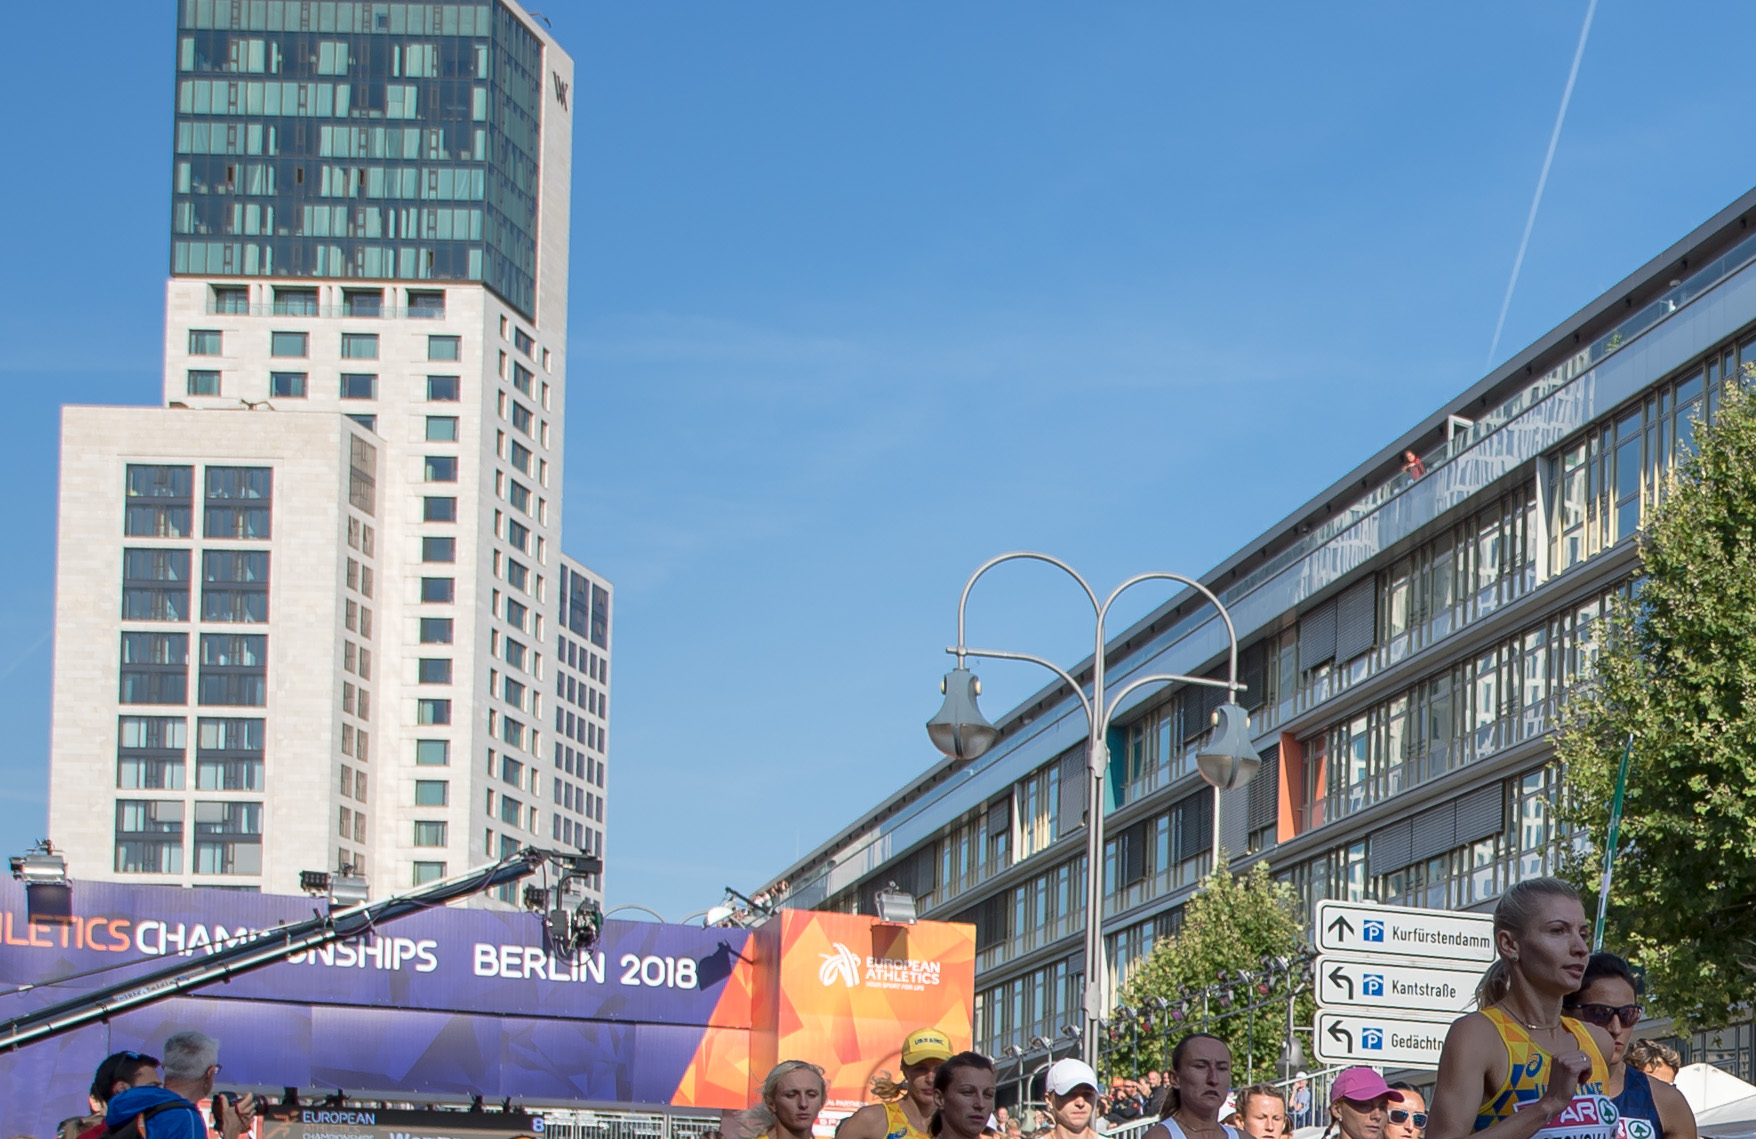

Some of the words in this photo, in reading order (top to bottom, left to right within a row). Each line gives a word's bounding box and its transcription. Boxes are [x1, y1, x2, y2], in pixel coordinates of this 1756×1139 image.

[1392, 925, 1490, 949] Kurfürstendamm
[0, 911, 131, 952] LETICS
[135, 919, 437, 973] CHAMNSHIPS
[474, 943, 605, 984] BERLIN
[620, 954, 698, 989] 2018
[865, 956, 940, 973] EUROPEAN
[865, 968, 940, 985] ATHLETICS
[1391, 980, 1456, 998] Kantstraße
[302, 1110, 375, 1125] EUROPEAN
